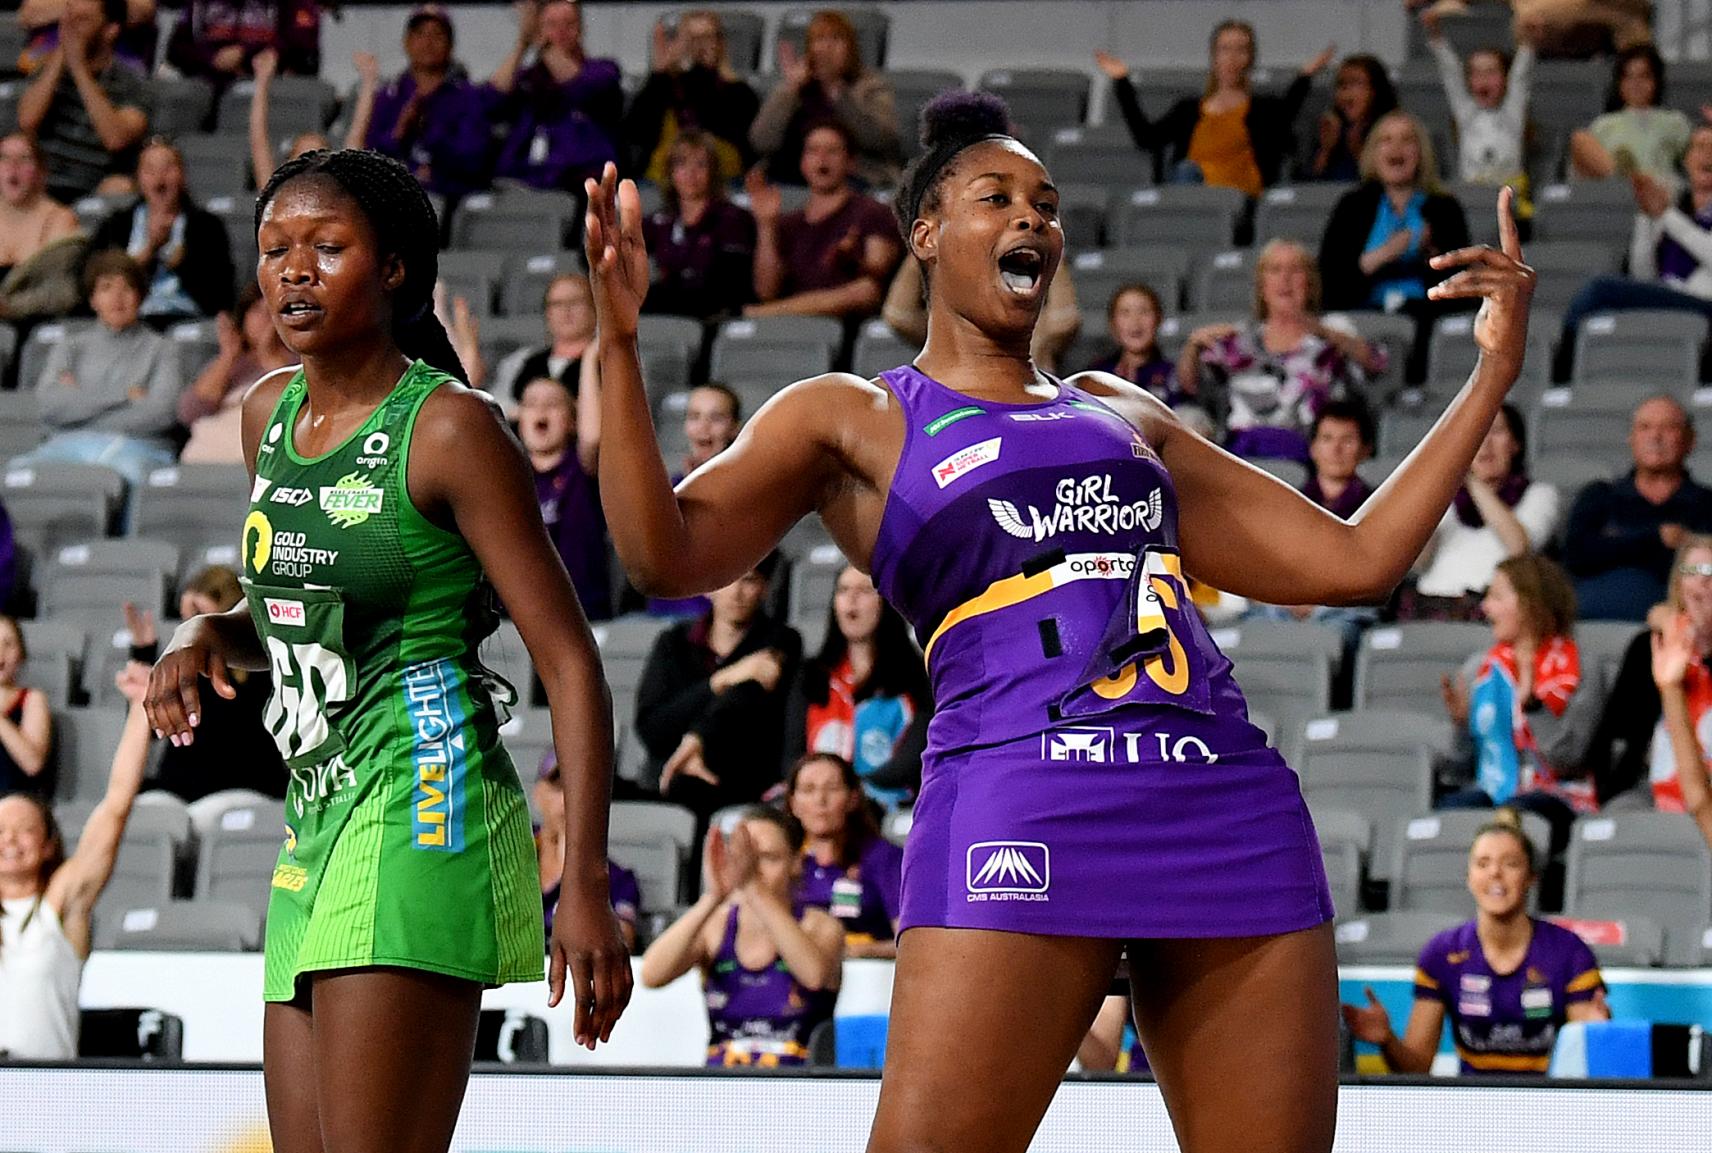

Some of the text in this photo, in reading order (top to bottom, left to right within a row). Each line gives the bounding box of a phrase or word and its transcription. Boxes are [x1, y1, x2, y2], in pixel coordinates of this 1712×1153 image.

[356, 456, 388, 469] origin
[323, 494, 379, 509] FEVER
[1028, 501, 1150, 542] WARRIOR
[274, 531, 306, 547] GOLD
[272, 546, 339, 566] INDUSTRY
[272, 561, 313, 578] GROUP
[281, 606, 302, 619] HCF
[266, 635, 347, 761] GD
[967, 893, 1050, 902] CMS AUSTRALASIA
